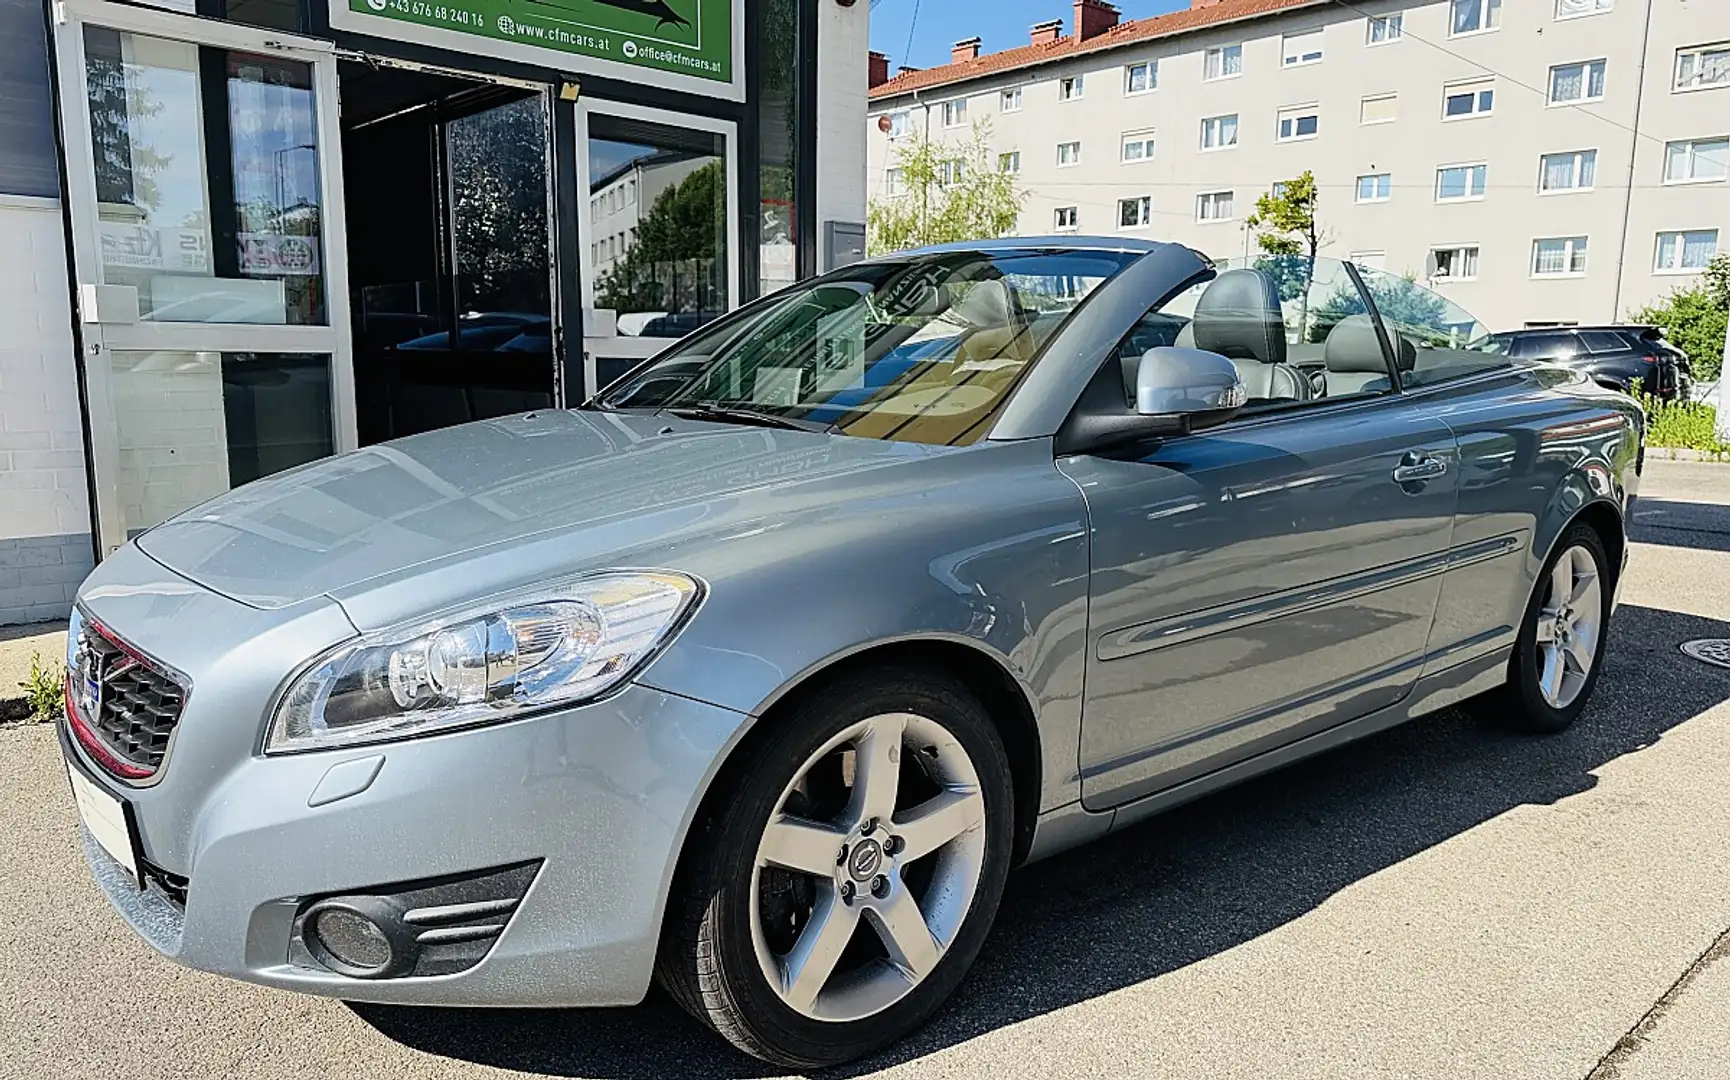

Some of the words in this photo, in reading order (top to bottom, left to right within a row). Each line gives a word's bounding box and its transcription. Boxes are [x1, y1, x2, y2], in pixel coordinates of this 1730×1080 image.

[389, 0, 410, 13] +43
[412, 2, 431, 17] 676
[435, 6, 447, 20] 68
[449, 9, 469, 24] 240
[472, 13, 484, 27] 16
[516, 22, 610, 51] www.cfmcars.at
[638, 47, 721, 73] office@cfmcars.at
